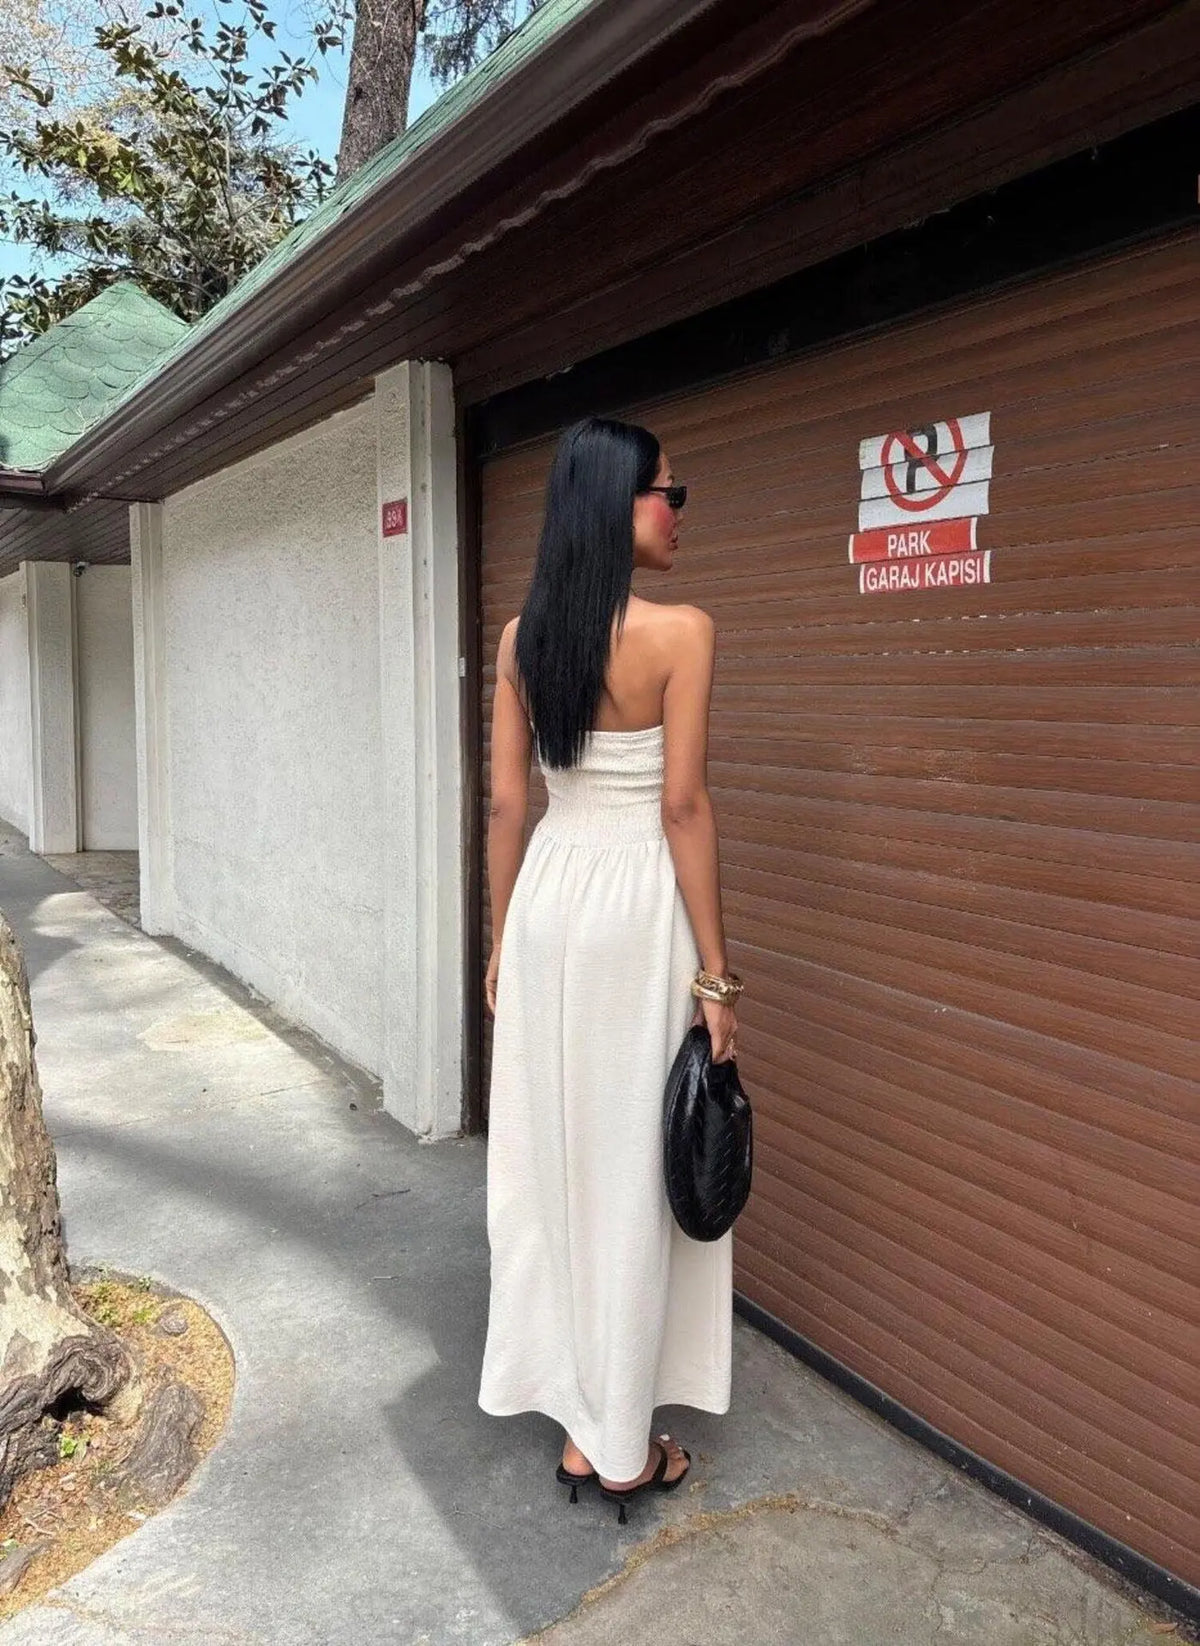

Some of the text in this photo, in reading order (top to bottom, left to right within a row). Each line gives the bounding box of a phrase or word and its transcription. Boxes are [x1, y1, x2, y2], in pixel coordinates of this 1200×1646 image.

[888, 530, 932, 557] PARK
[866, 558, 981, 591] GARAJ KAPISI
